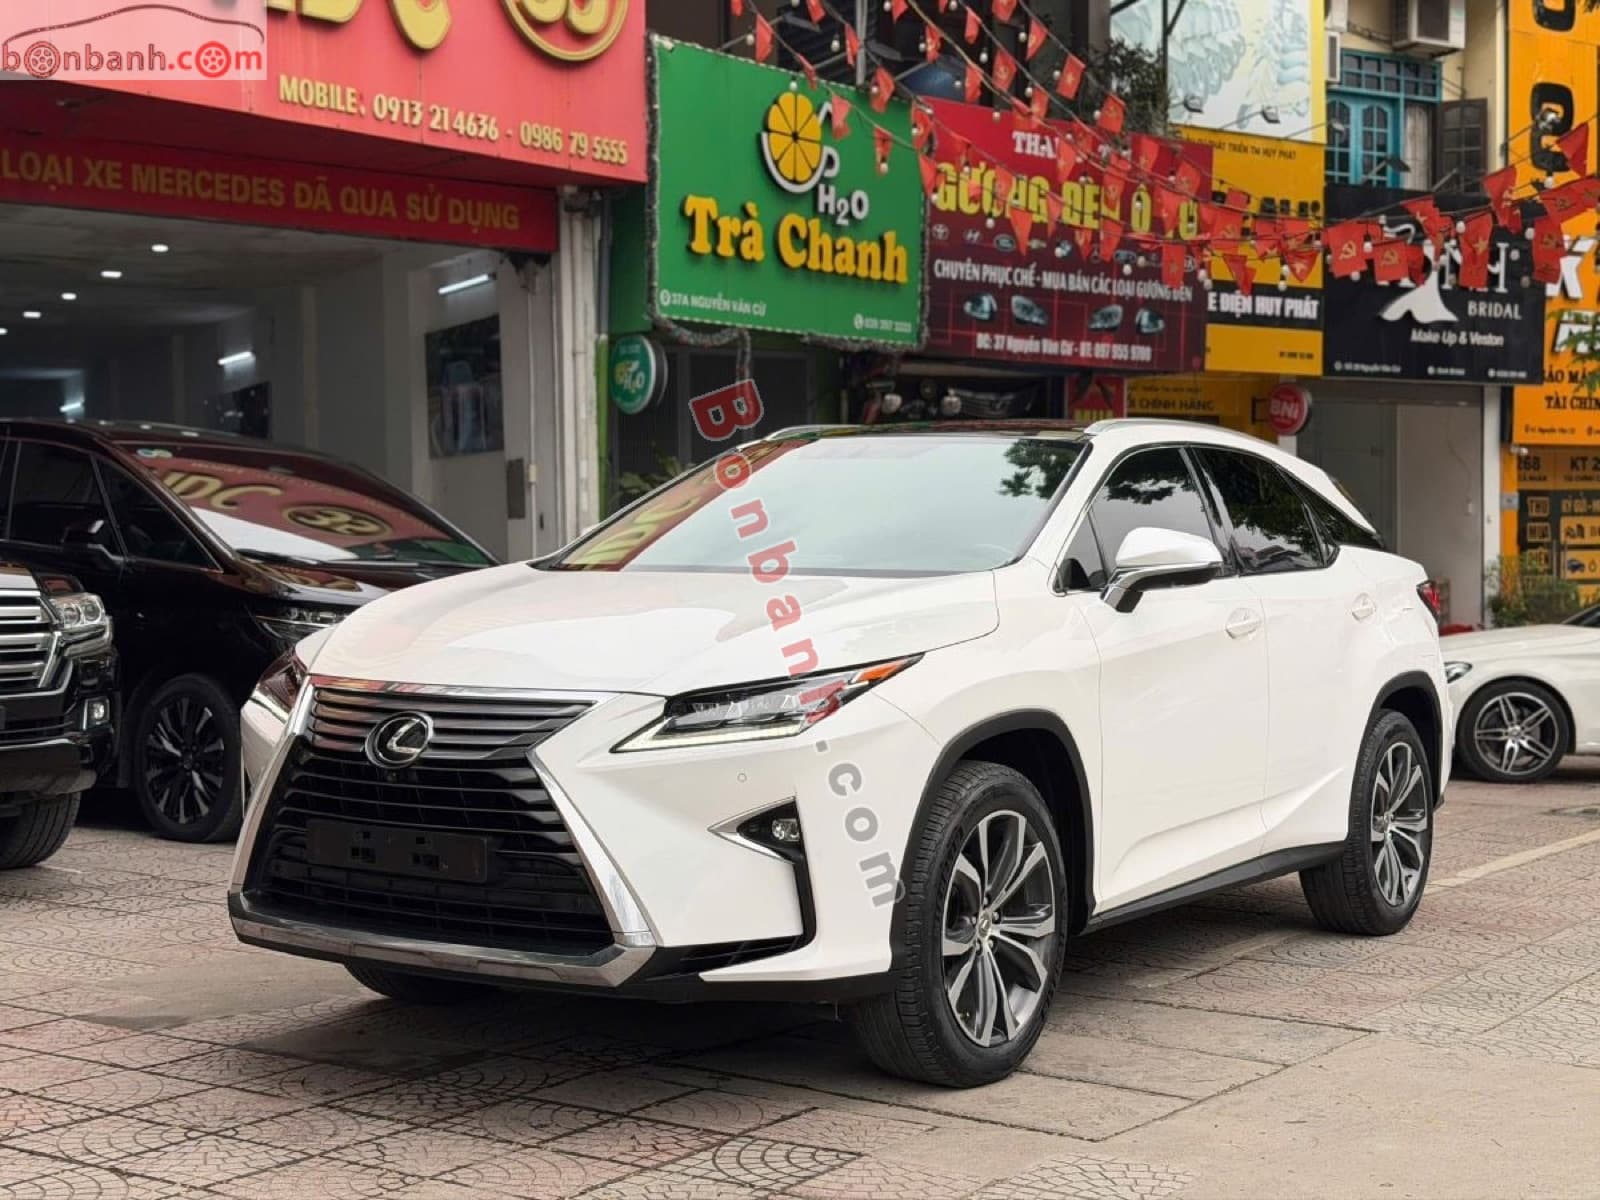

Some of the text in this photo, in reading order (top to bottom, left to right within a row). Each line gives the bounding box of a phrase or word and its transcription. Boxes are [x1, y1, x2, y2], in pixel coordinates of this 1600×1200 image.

[373, 93, 422, 126] 0913
[519, 121, 563, 152] 0986
[570, 132, 588, 157] 79
[592, 136, 628, 165] 5555
[83, 158, 124, 189] XE
[131, 163, 285, 208] MERCEDES
[294, 176, 332, 213] ĐÃ
[339, 185, 397, 219] QUA
[447, 198, 520, 234] DỤNG
[817, 183, 870, 226] H2O
[684, 194, 909, 283] Trà Chanh
[934, 256, 980, 282] CHUYÊN
[982, 264, 1012, 288] PHỤC
[1013, 261, 1036, 288] CHẾ
[1042, 270, 1067, 291] MUA
[1068, 269, 1090, 293] BÁN
[1091, 271, 1111, 295] CÁC
[1219, 289, 1253, 318] ĐIỆN
[1255, 295, 1282, 317] HUY
[1284, 295, 1319, 320] PHÁT
[1467, 300, 1522, 321] BRIDAL
[1441, 329, 1457, 348] Up
[1458, 330, 1468, 346] &
